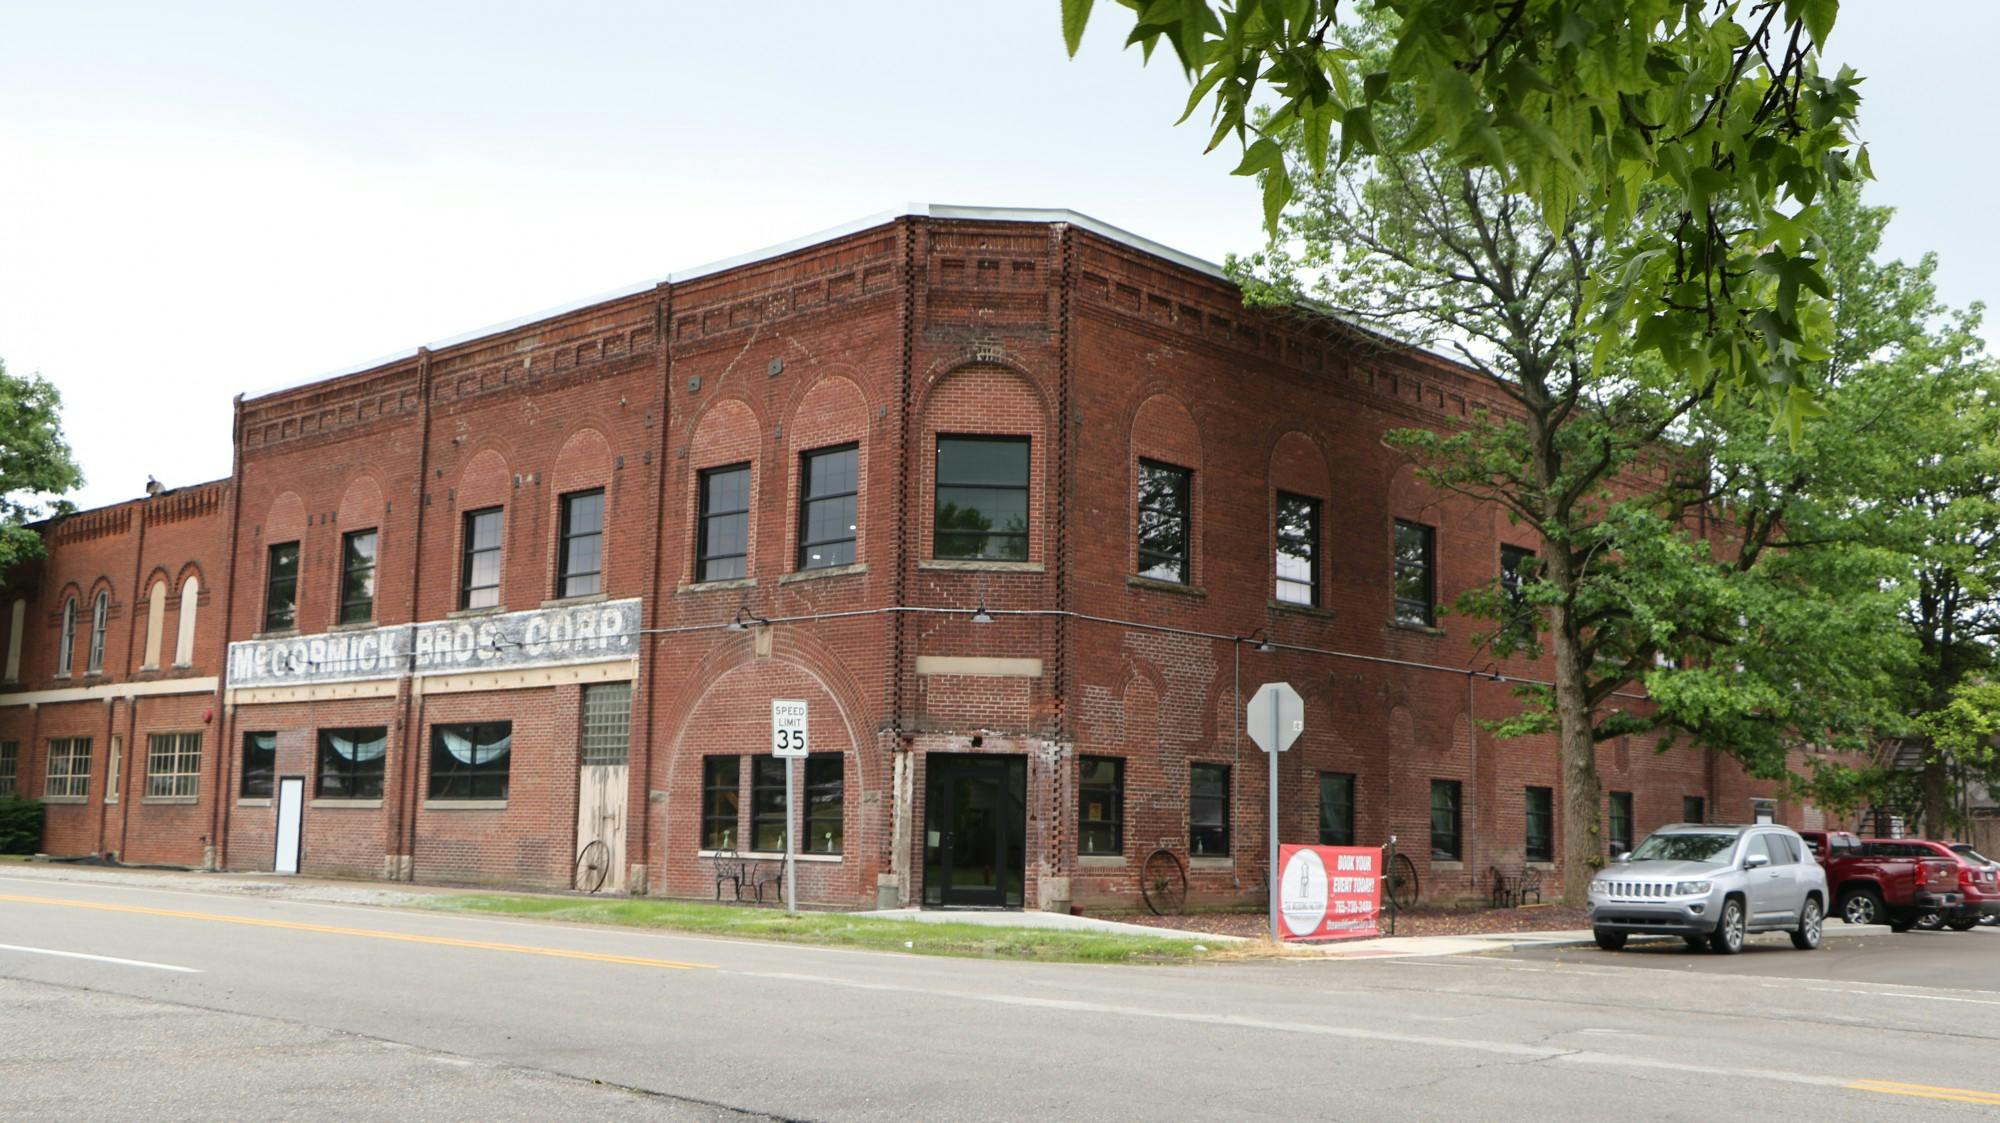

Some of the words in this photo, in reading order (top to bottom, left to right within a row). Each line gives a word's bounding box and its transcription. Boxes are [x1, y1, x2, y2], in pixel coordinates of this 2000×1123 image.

[524, 609, 629, 656] CORP.
[775, 706, 805, 716] SPEED
[779, 718, 801, 727] LIMIT
[777, 729, 805, 750] 35
[1337, 855, 1355, 871] BOOK
[1355, 855, 1372, 871] YOUR
[1333, 877, 1352, 893] EVENT
